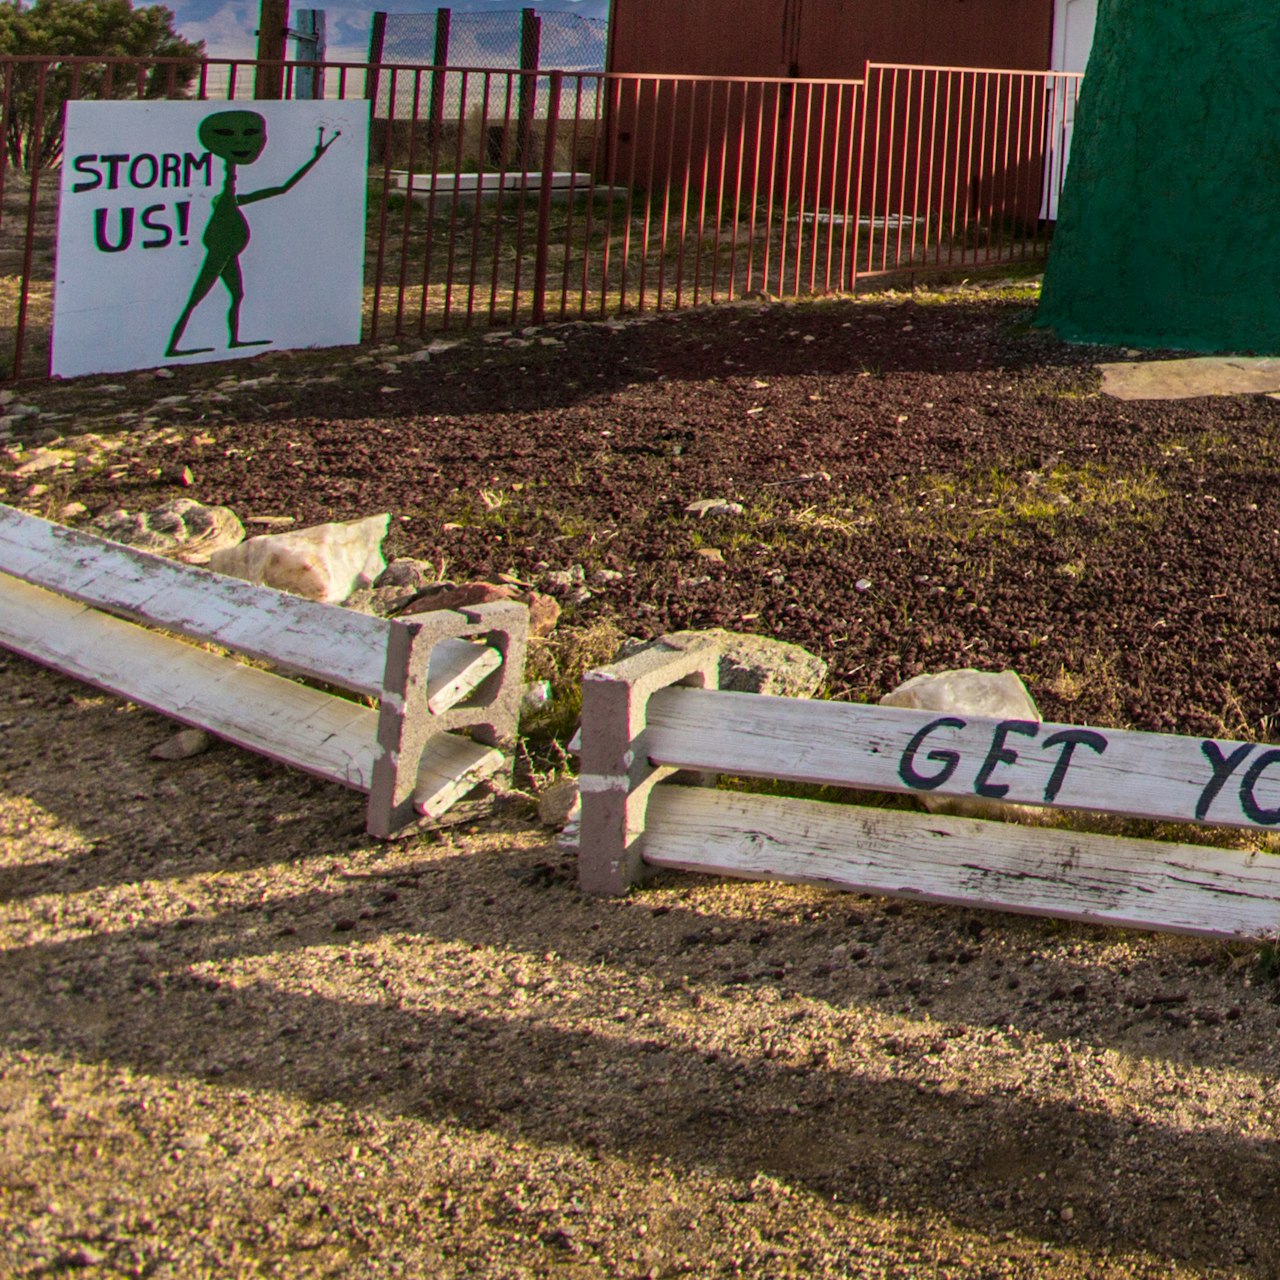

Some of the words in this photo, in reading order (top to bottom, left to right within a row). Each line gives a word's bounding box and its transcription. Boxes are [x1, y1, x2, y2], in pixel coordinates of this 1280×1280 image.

[73, 152, 212, 193] STORM
[94, 201, 191, 253] US!
[898, 717, 1108, 803] GET
